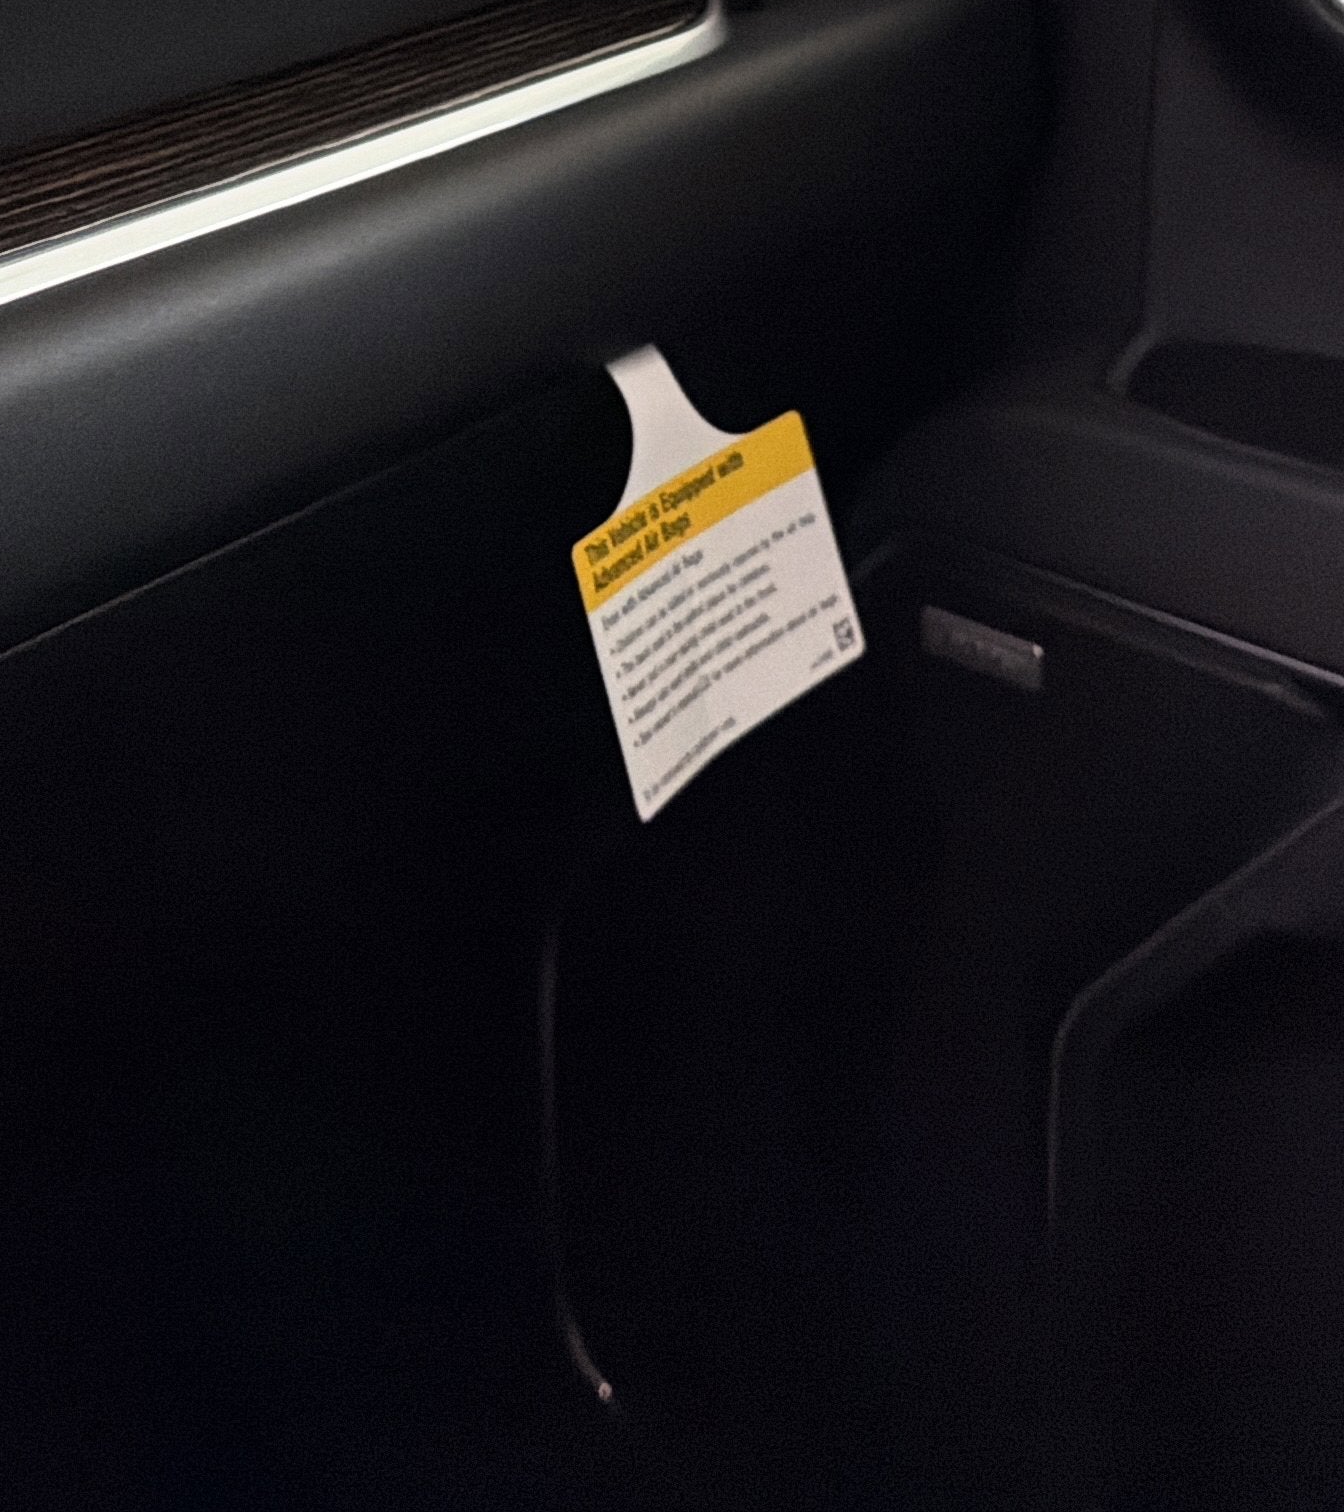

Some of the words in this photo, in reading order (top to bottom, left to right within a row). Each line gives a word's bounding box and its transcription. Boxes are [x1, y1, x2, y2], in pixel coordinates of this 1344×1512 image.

[649, 503, 659, 520] is
[659, 468, 715, 512] Equipped
[717, 452, 744, 478] with
[594, 543, 644, 593] Advanced
